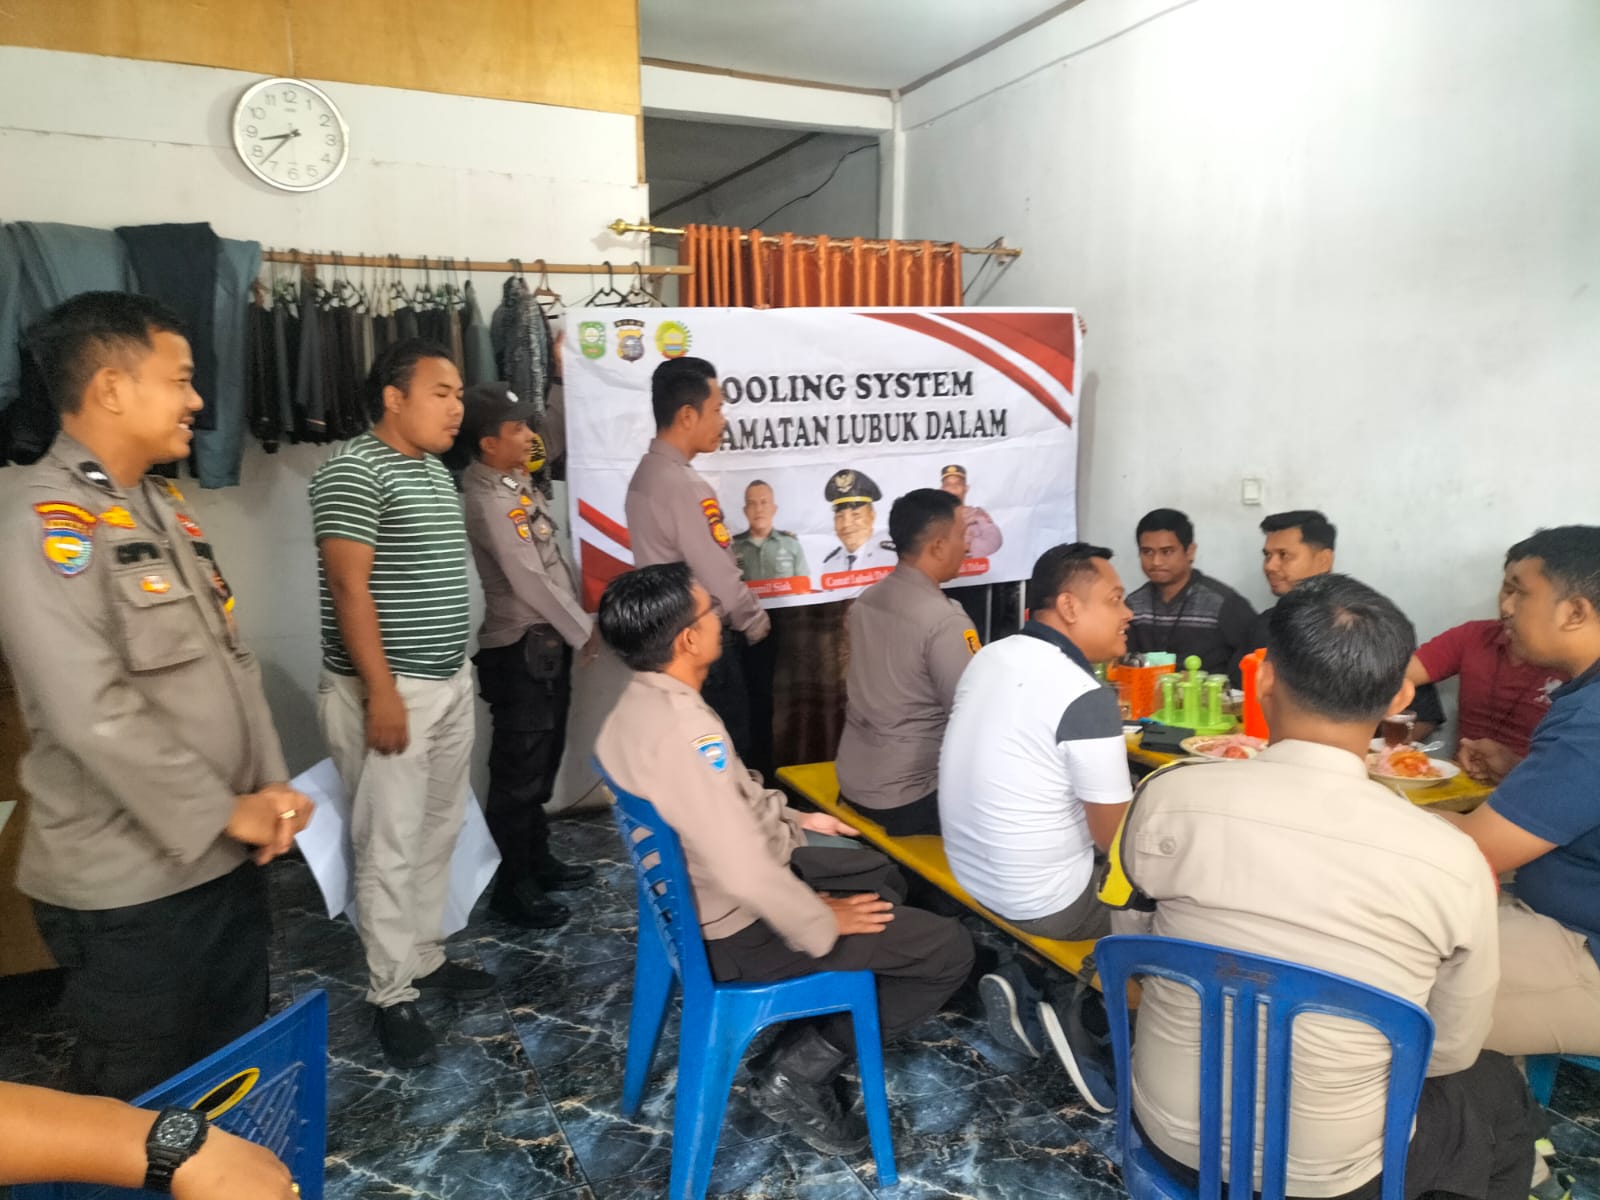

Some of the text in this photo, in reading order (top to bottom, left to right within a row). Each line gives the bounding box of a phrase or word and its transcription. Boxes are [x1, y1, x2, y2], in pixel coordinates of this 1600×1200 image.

[264, 94, 276, 106] 11
[282, 90, 298, 104] 12
[248, 106, 266, 120] 10
[319, 114, 331, 127] 2
[246, 125, 258, 138] 9
[326, 134, 337, 146] 3
[252, 145, 264, 158] 8
[321, 153, 331, 164] 4
[269, 160, 279, 171] 7
[307, 165, 318, 177] 5
[287, 168, 298, 180] 6
[722, 371, 974, 404] OOLING SYSTEM
[719, 408, 1008, 451] AMATAN LUBUK DALAM
